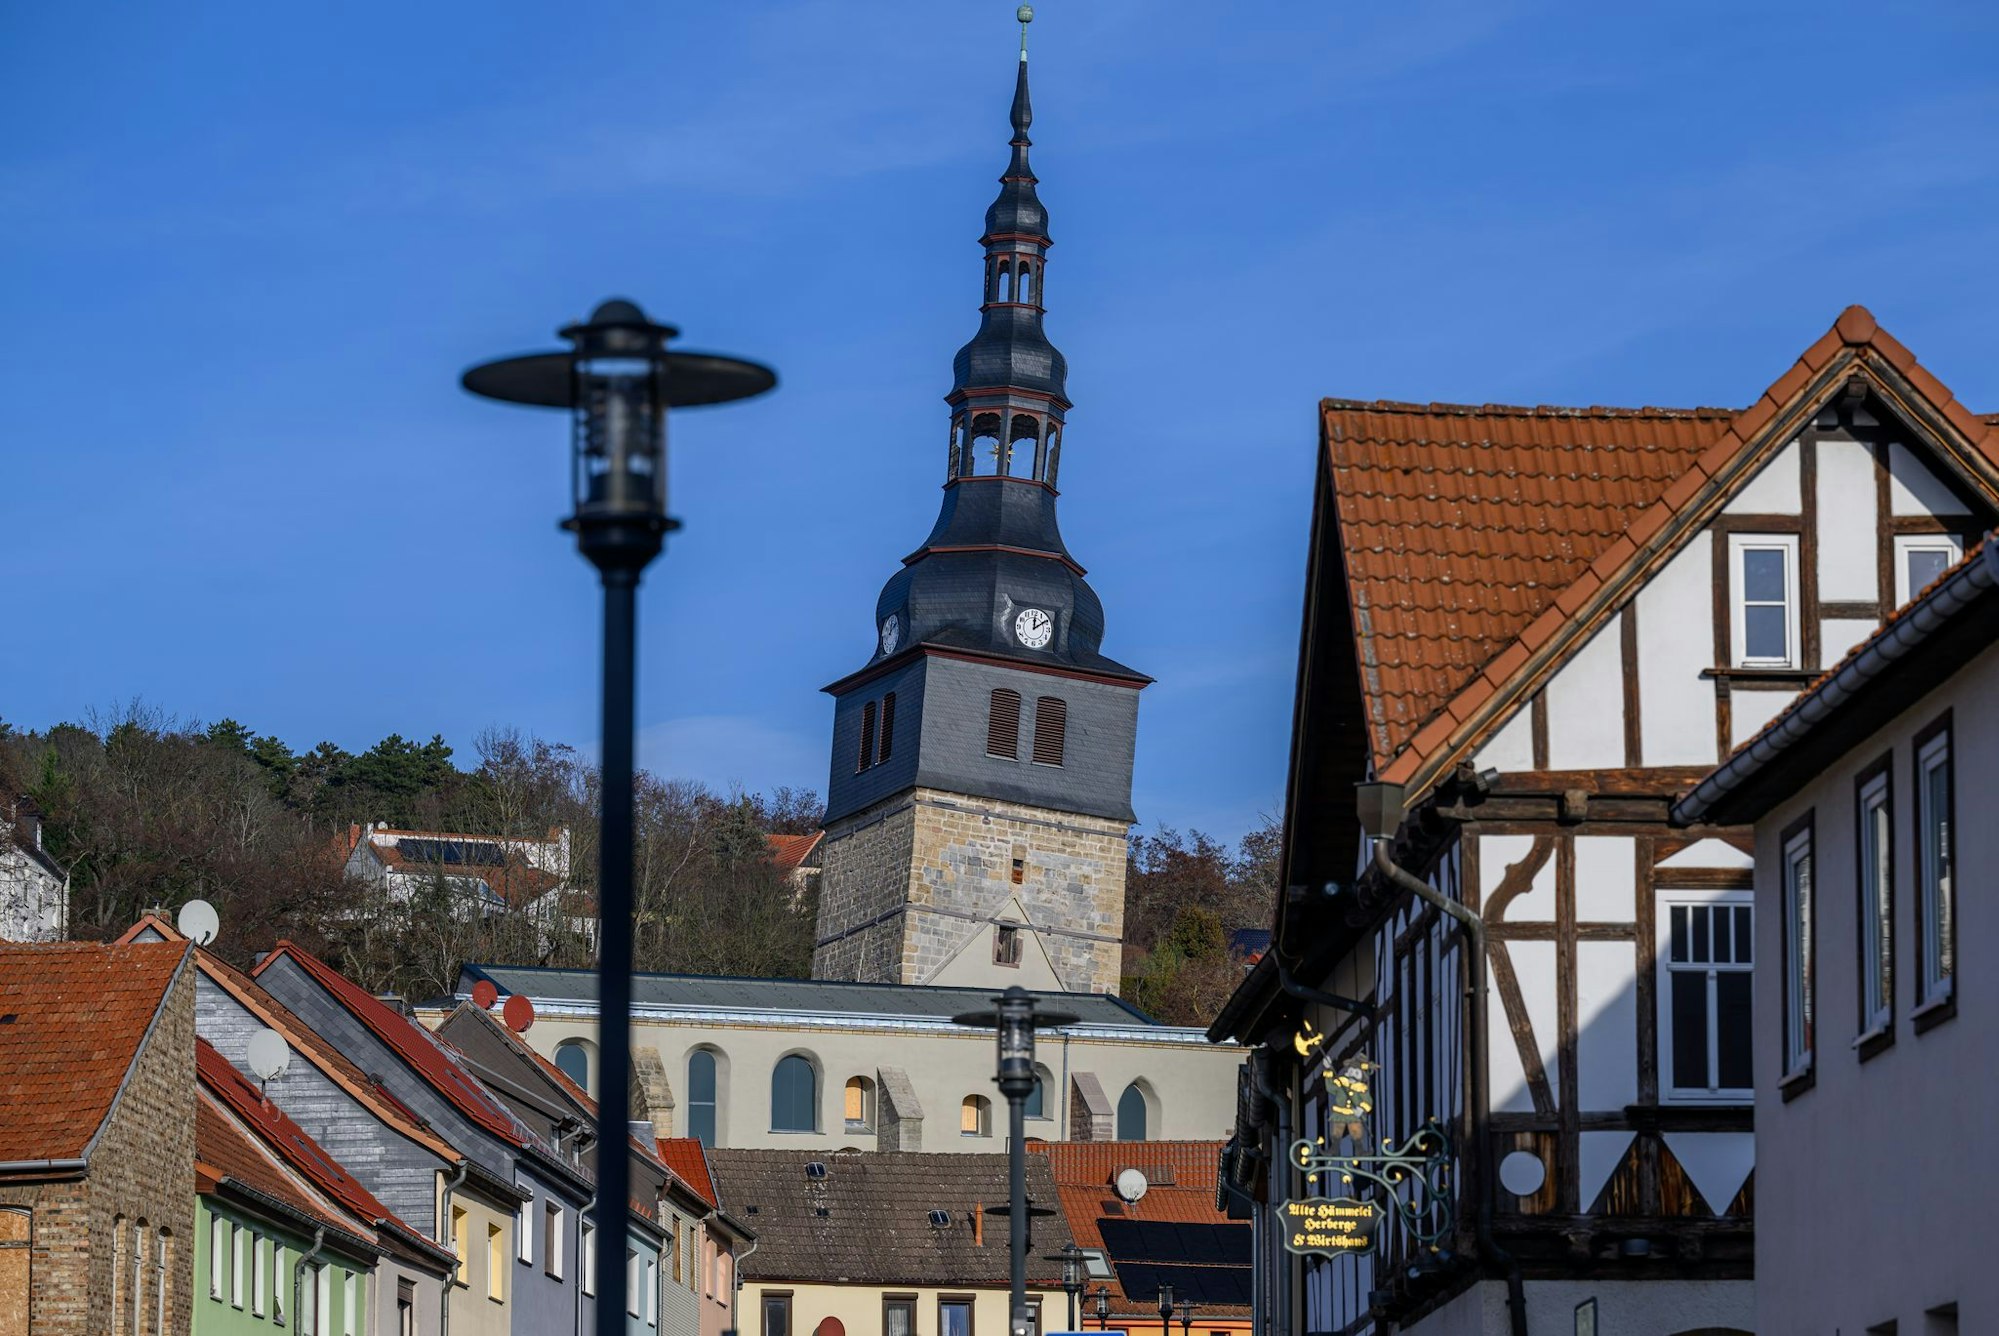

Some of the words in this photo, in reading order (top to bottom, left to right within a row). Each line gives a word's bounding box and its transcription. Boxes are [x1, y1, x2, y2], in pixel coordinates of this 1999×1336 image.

[1288, 1203, 1316, 1216] Alte
[1304, 1218, 1357, 1233] Herberge
[1306, 1234, 1368, 1249] Wirtshaus
